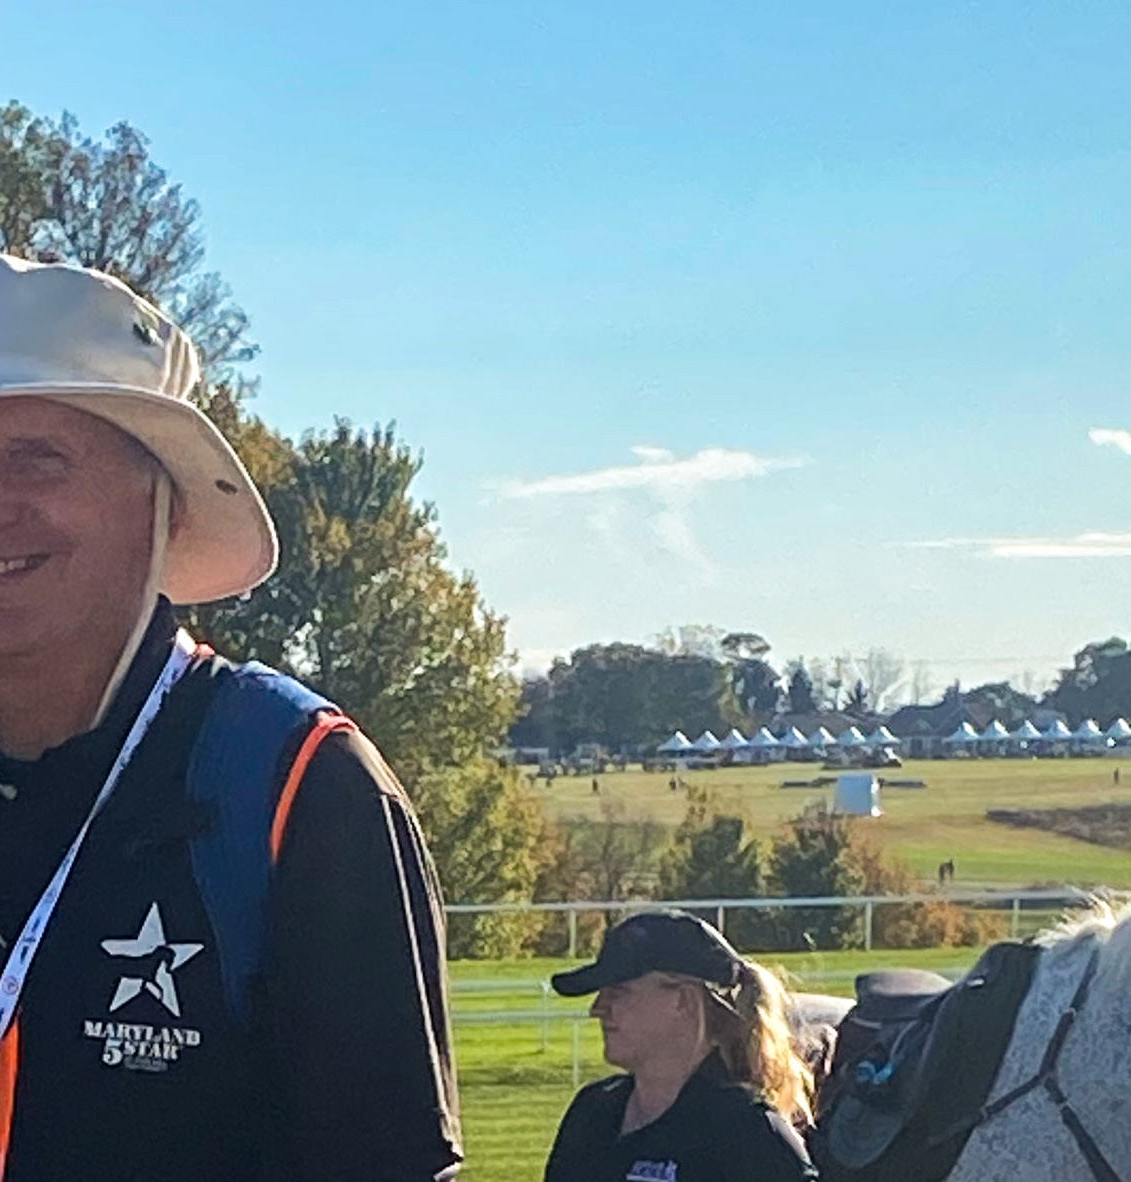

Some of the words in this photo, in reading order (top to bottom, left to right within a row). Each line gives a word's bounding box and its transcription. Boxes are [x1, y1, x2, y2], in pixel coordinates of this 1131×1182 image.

[84, 1020, 200, 1046] MARYLAND
[102, 1038, 123, 1065] 5
[123, 1041, 179, 1060] STAR
